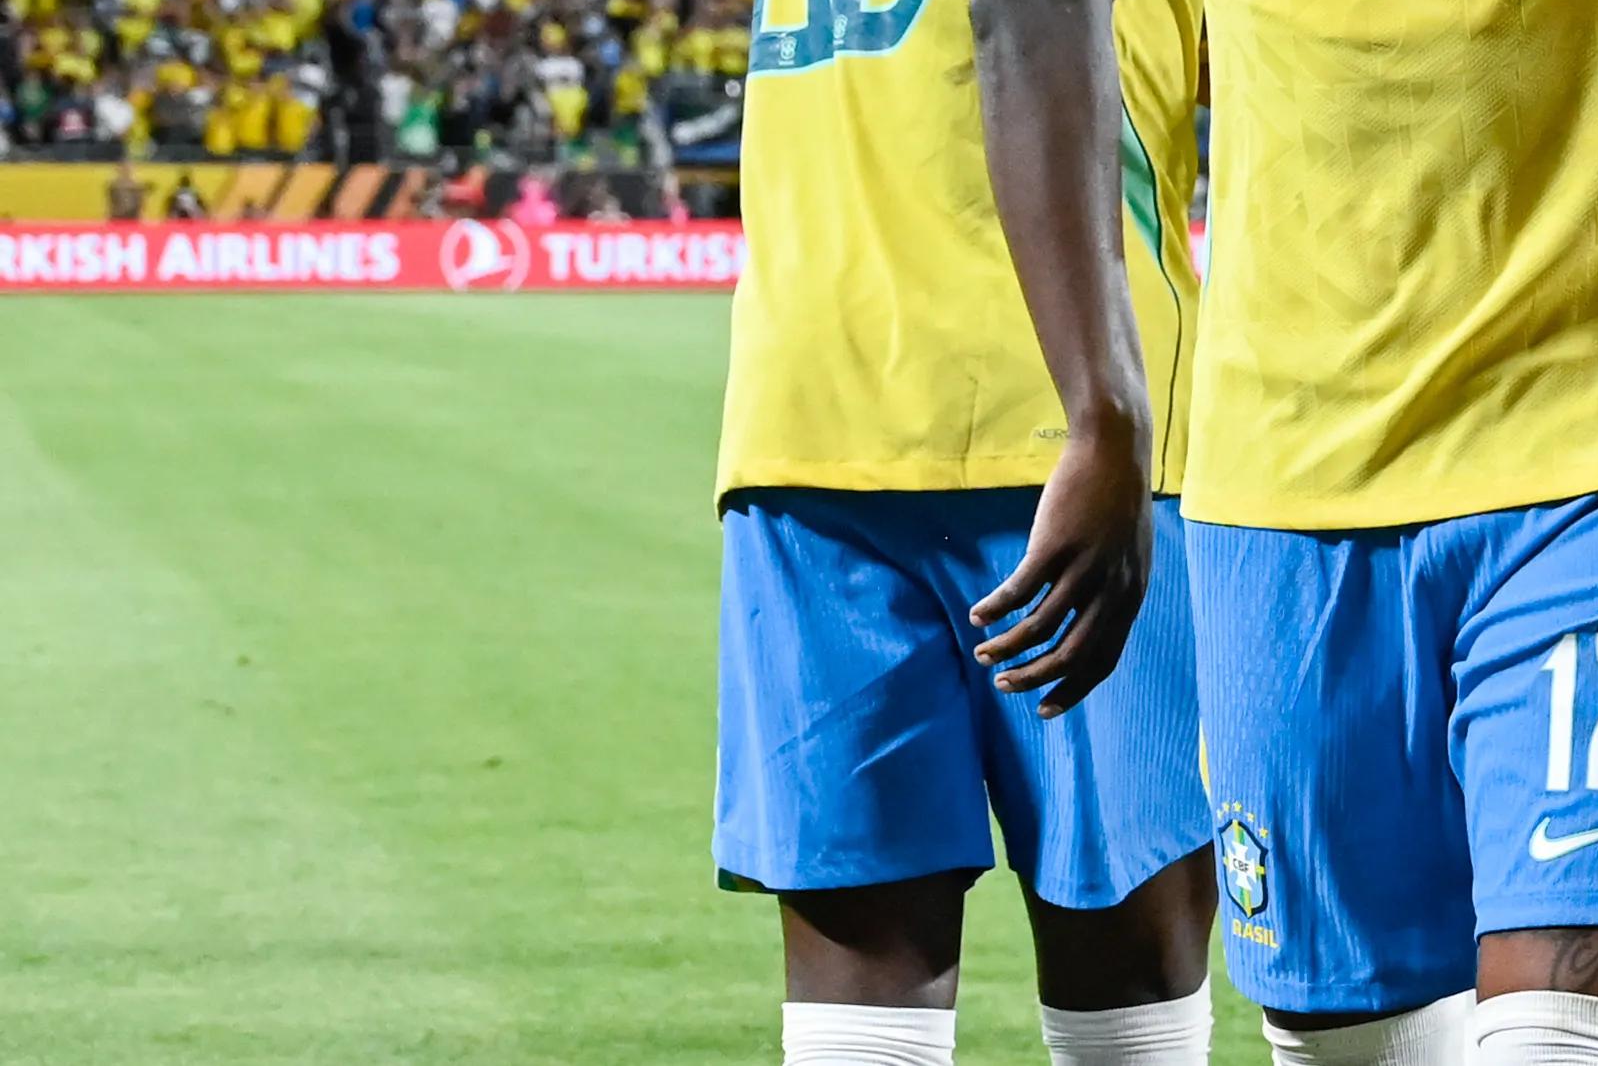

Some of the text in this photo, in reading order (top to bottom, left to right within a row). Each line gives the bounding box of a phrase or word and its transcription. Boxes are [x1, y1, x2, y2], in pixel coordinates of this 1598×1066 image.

[157, 233, 400, 283] AIRLINES
[540, 233, 749, 282] TURKIS
[1232, 918, 1280, 949] RASIL
